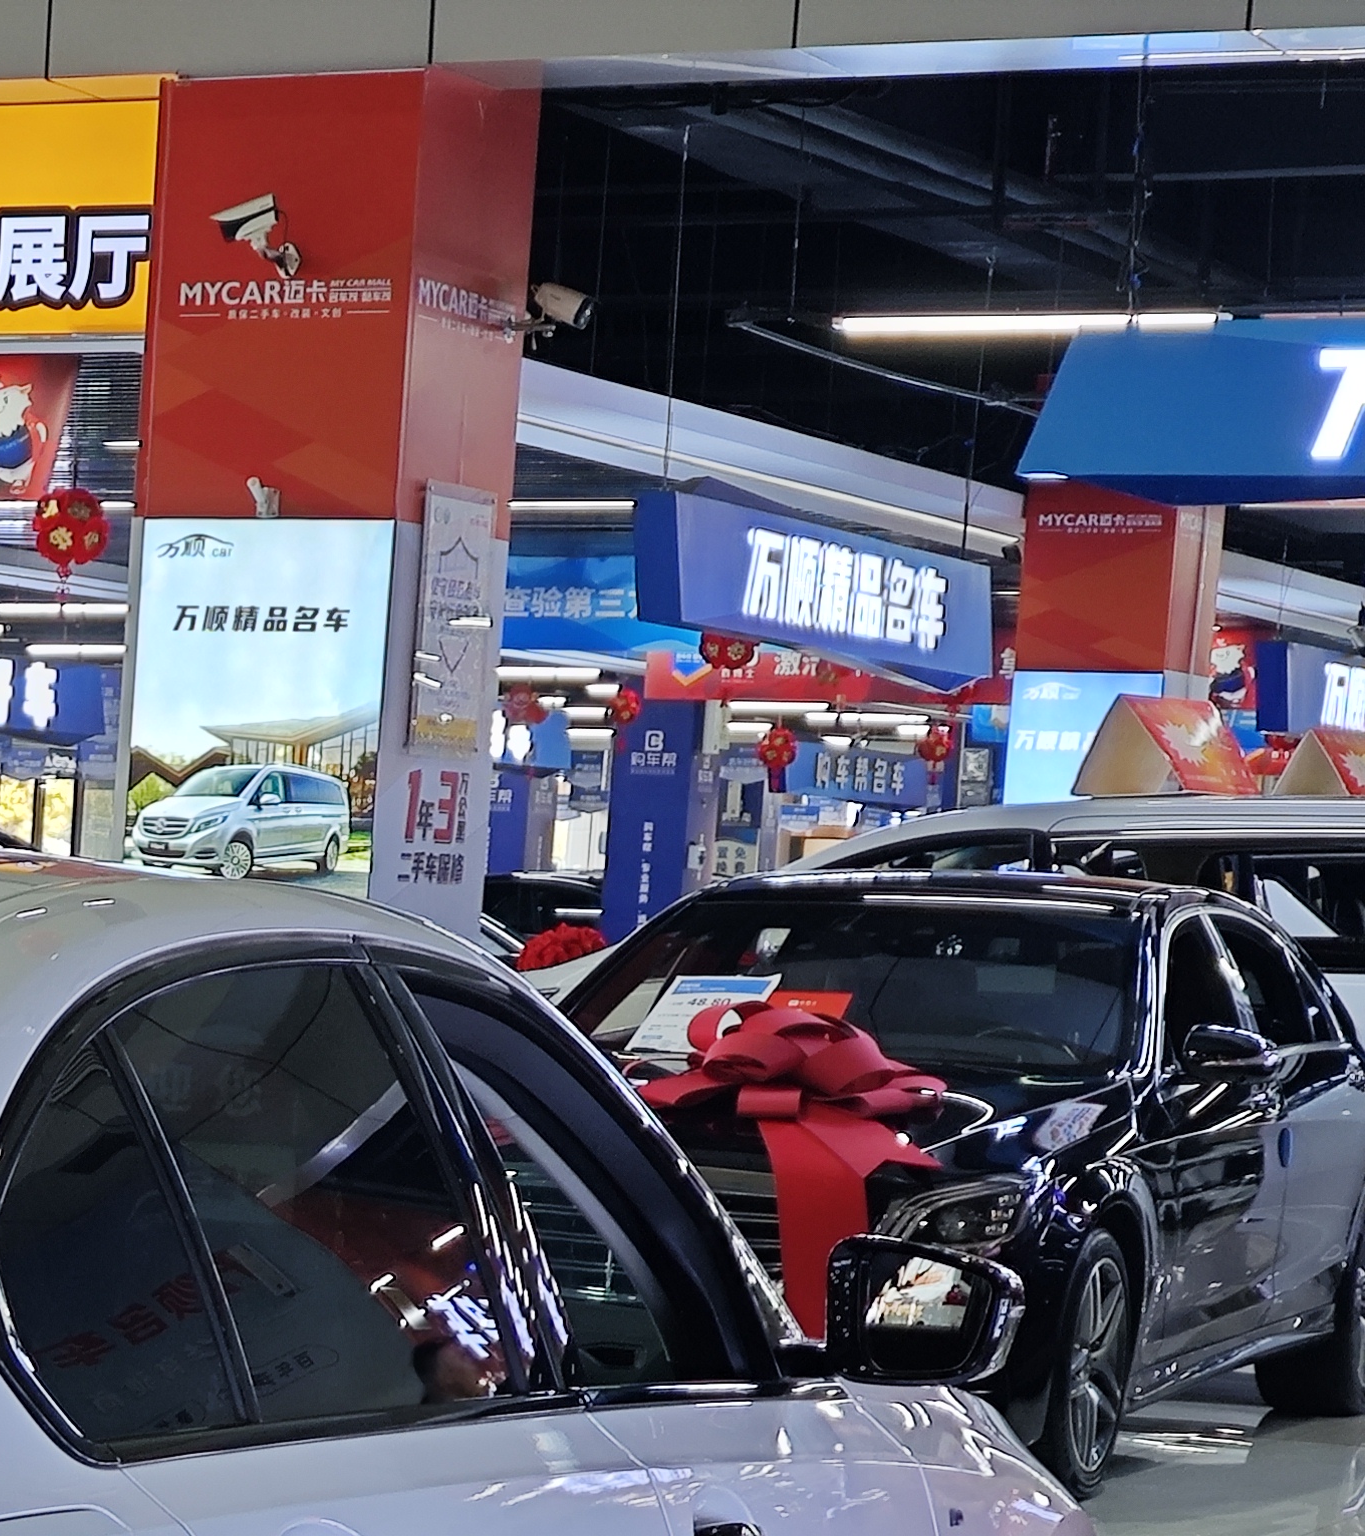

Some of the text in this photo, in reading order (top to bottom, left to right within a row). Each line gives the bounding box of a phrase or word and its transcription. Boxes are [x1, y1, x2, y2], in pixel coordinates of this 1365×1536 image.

[742, 526, 950, 651] 万顺精品名车
[172, 604, 351, 633] 万顺精品名车
[630, 751, 677, 768] 购车帮
